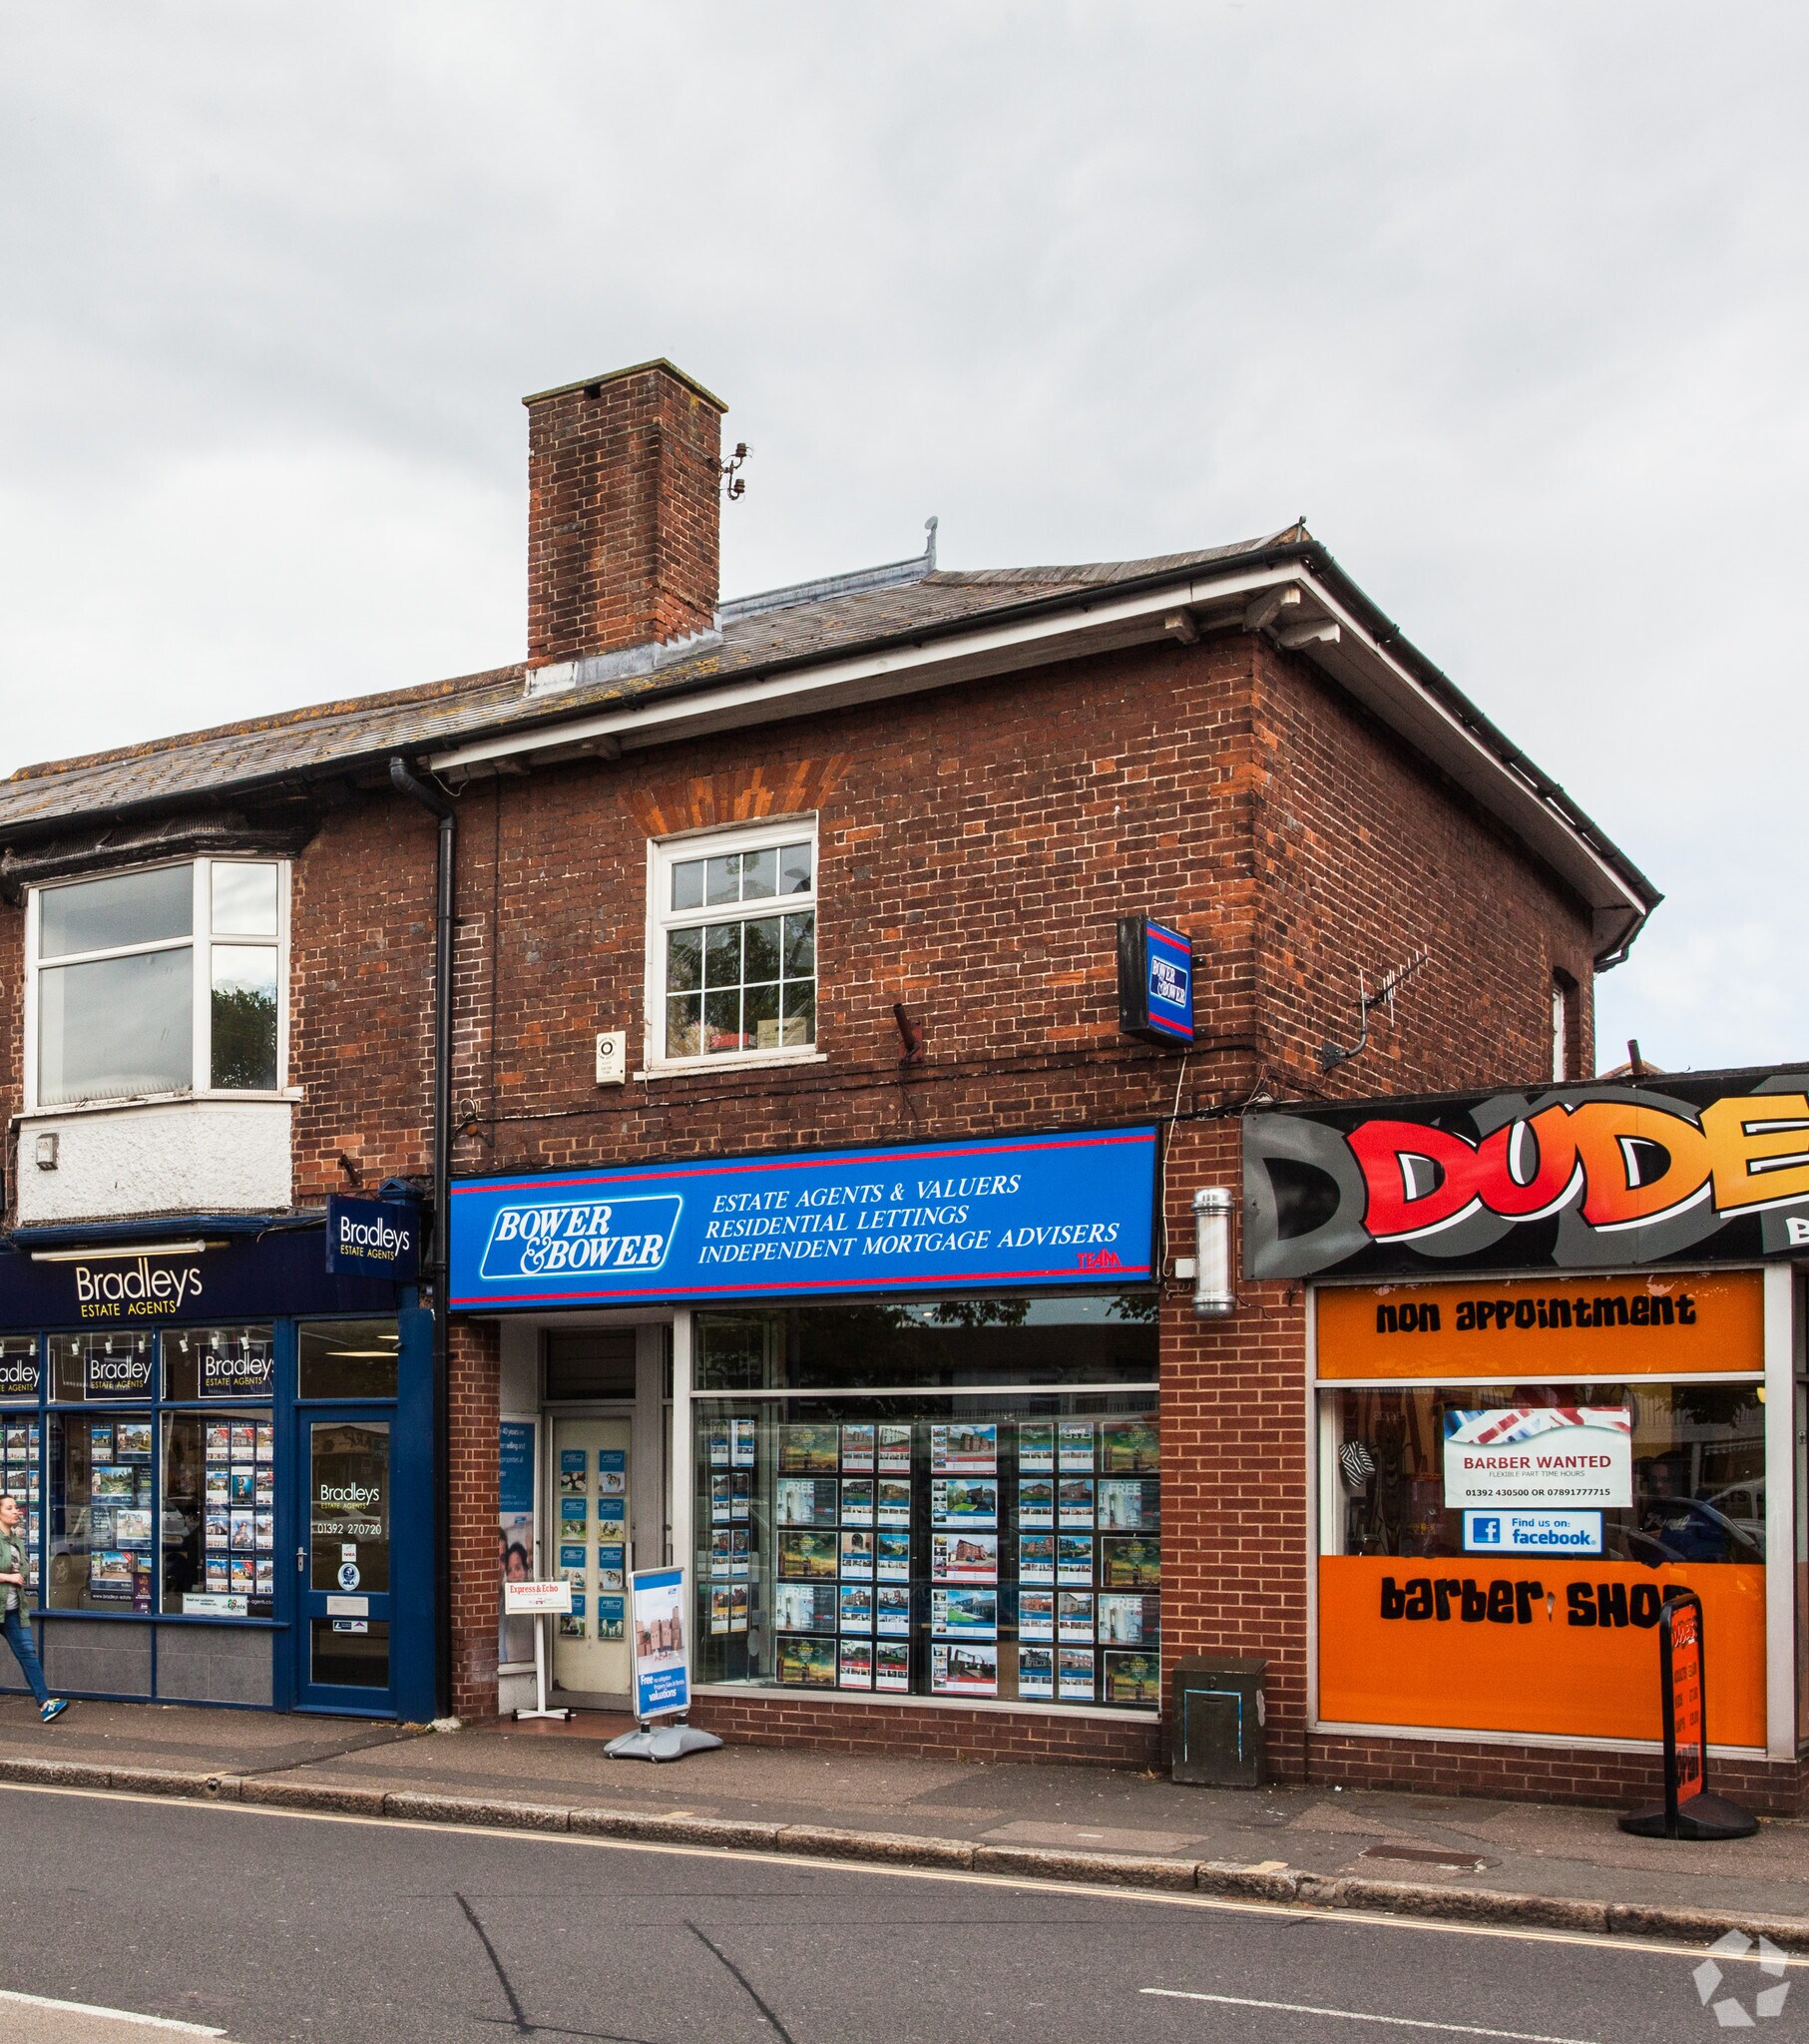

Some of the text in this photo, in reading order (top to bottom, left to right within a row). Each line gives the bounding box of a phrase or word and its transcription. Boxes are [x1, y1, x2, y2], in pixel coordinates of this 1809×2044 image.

[712, 1175, 1022, 1213] ESTATE AGENTS & VALUERS
[495, 1206, 612, 1241] BOWER
[705, 1205, 969, 1239] RESIDENTIAL LETTINGS
[340, 1216, 410, 1257] Bradleys
[698, 1223, 1120, 1264] INDEPENDENT MORTGAGE ADVISERS
[340, 1245, 395, 1262] ESTATE AGENTS
[1076, 1248, 1122, 1268] TEAM
[76, 1258, 203, 1306] Bradleys
[81, 1300, 177, 1317] ESTATE AGENTS
[1376, 1292, 1696, 1334] non appointment
[8, 1383, 34, 1392] AGENTS
[90, 1379, 144, 1389] ESTATE AGENTS
[206, 1376, 262, 1386] ESTATE AGENTS
[1464, 1455, 1611, 1469] BARBER WANTED
[320, 1482, 380, 1505] Bradleys
[317, 1523, 382, 1535] 01392 270720
[1512, 1517, 1535, 1527] Find
[1538, 1519, 1551, 1528] us
[1512, 1528, 1591, 1545] facebook
[510, 1585, 536, 1595] Express
[542, 1584, 559, 1593] Echo
[640, 1675, 654, 1686] Free
